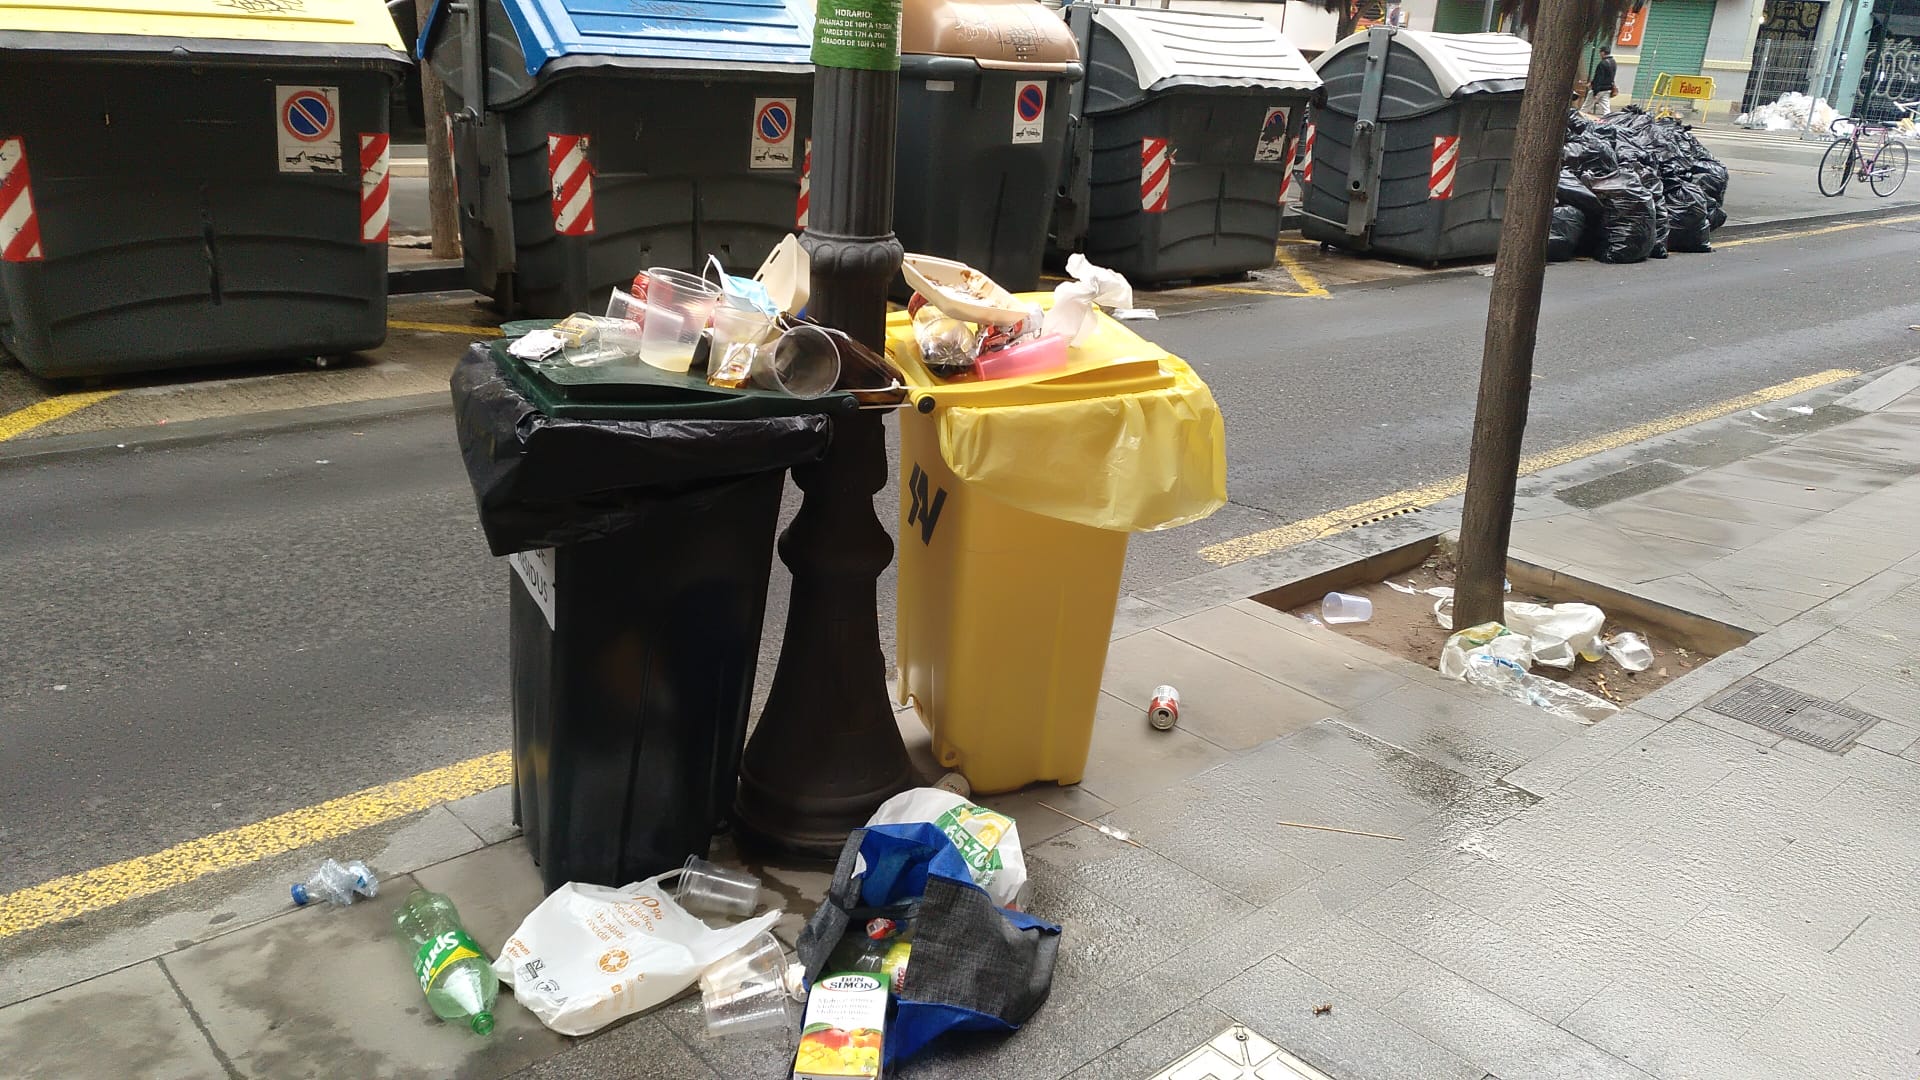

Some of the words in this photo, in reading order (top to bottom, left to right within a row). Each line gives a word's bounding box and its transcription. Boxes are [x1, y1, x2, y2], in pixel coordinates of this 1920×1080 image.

[835, 8, 873, 19] HORARIO:
[819, 18, 843, 27] MAÑANAS
[845, 20, 853, 28] DE
[823, 27, 843, 36] TARDES
[854, 30, 867, 38] 17H
[821, 36, 846, 46] SÁBADOS
[847, 38, 855, 46] DE
[857, 39, 869, 48] 10H
[420, 931, 459, 993] Sprite
